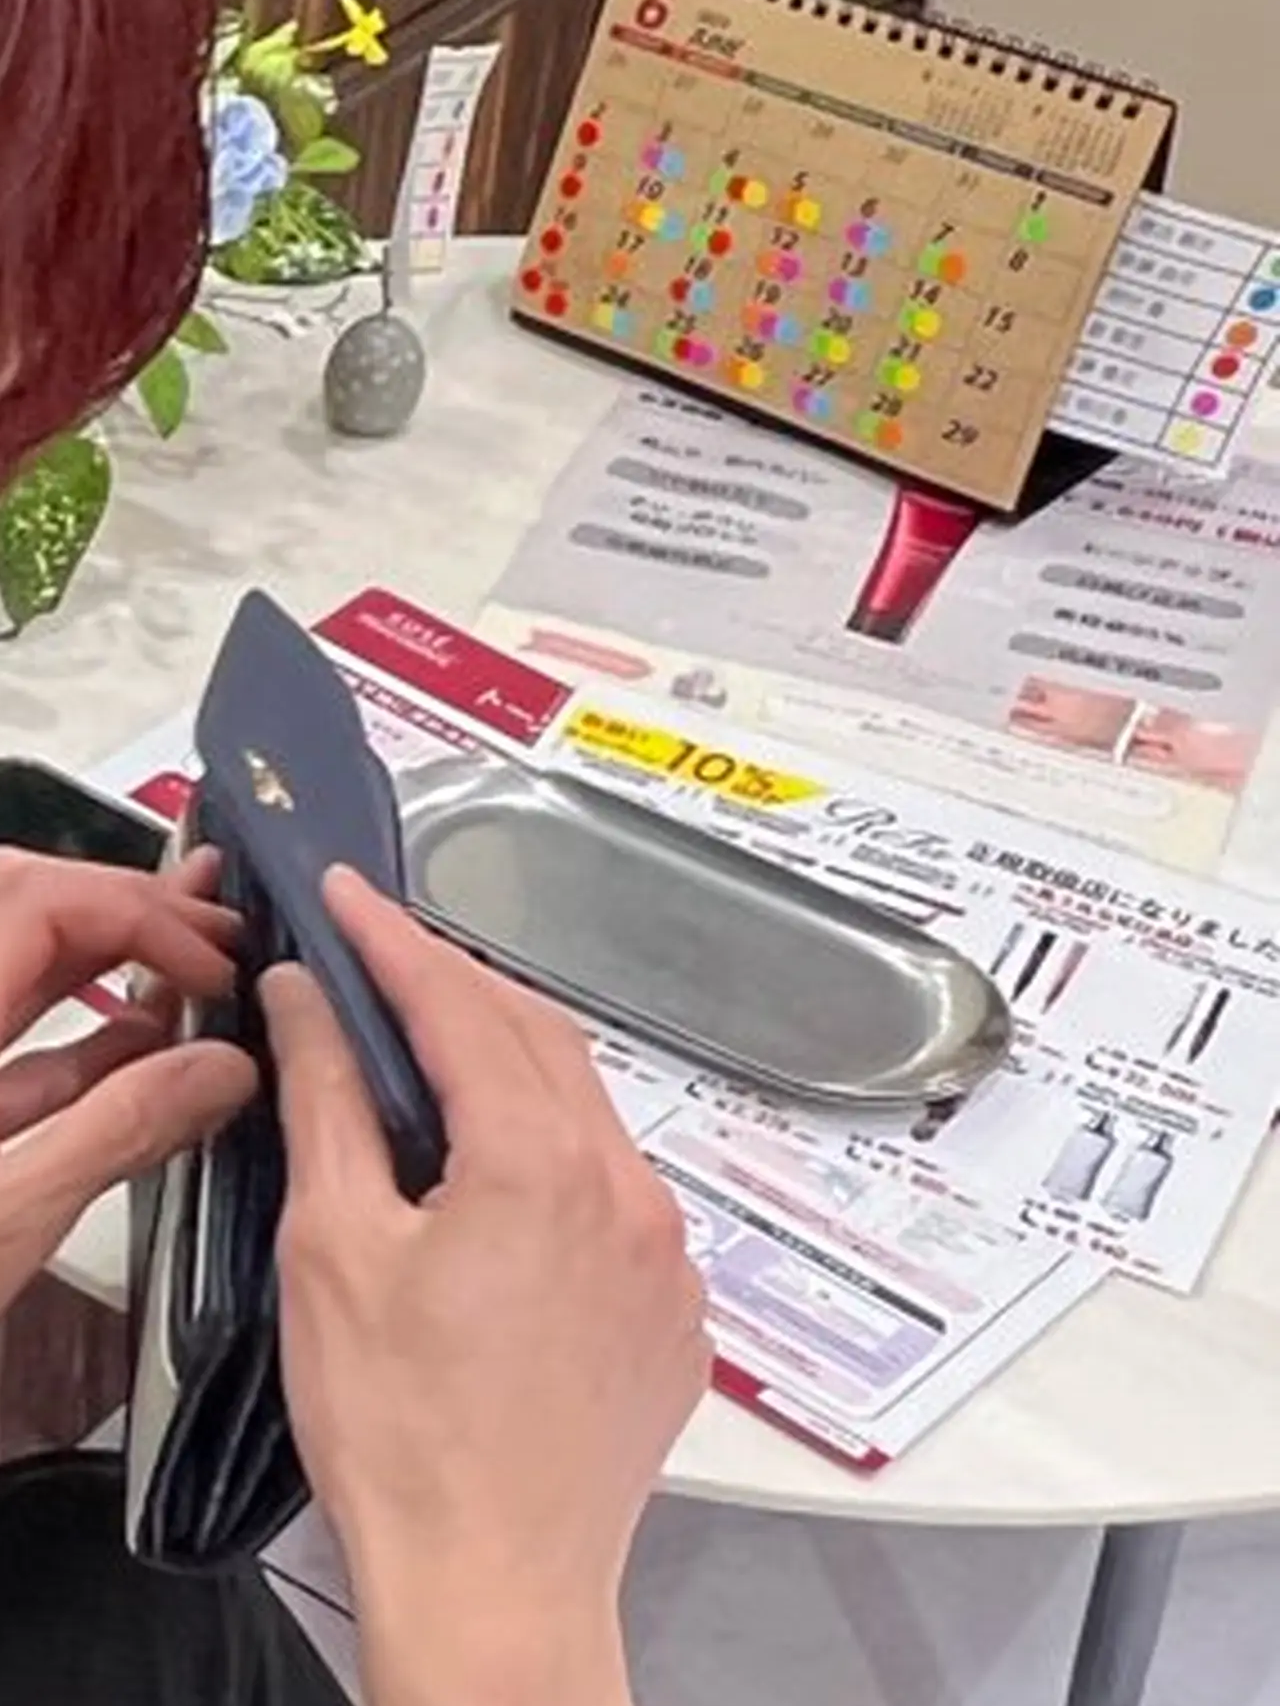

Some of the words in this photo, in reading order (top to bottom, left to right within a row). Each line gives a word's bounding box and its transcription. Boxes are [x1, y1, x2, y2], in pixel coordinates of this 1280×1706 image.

[637, 176, 666, 200] 10
[702, 201, 729, 223] 11
[770, 226, 800, 250] 12
[841, 252, 868, 277] 13
[908, 279, 942, 305] 14
[983, 306, 1016, 334] 15
[792, 171, 809, 192] 5
[859, 197, 880, 218] 6
[932, 222, 955, 243] 7
[1009, 248, 1030, 272] 8
[617, 230, 645, 253] 17
[684, 257, 713, 280] 18
[755, 280, 781, 304] 19
[822, 306, 853, 335] 20
[890, 335, 922, 361] 21
[963, 364, 998, 391] 22
[802, 363, 836, 386] 27
[871, 393, 904, 417] 28
[941, 418, 979, 447] 29
